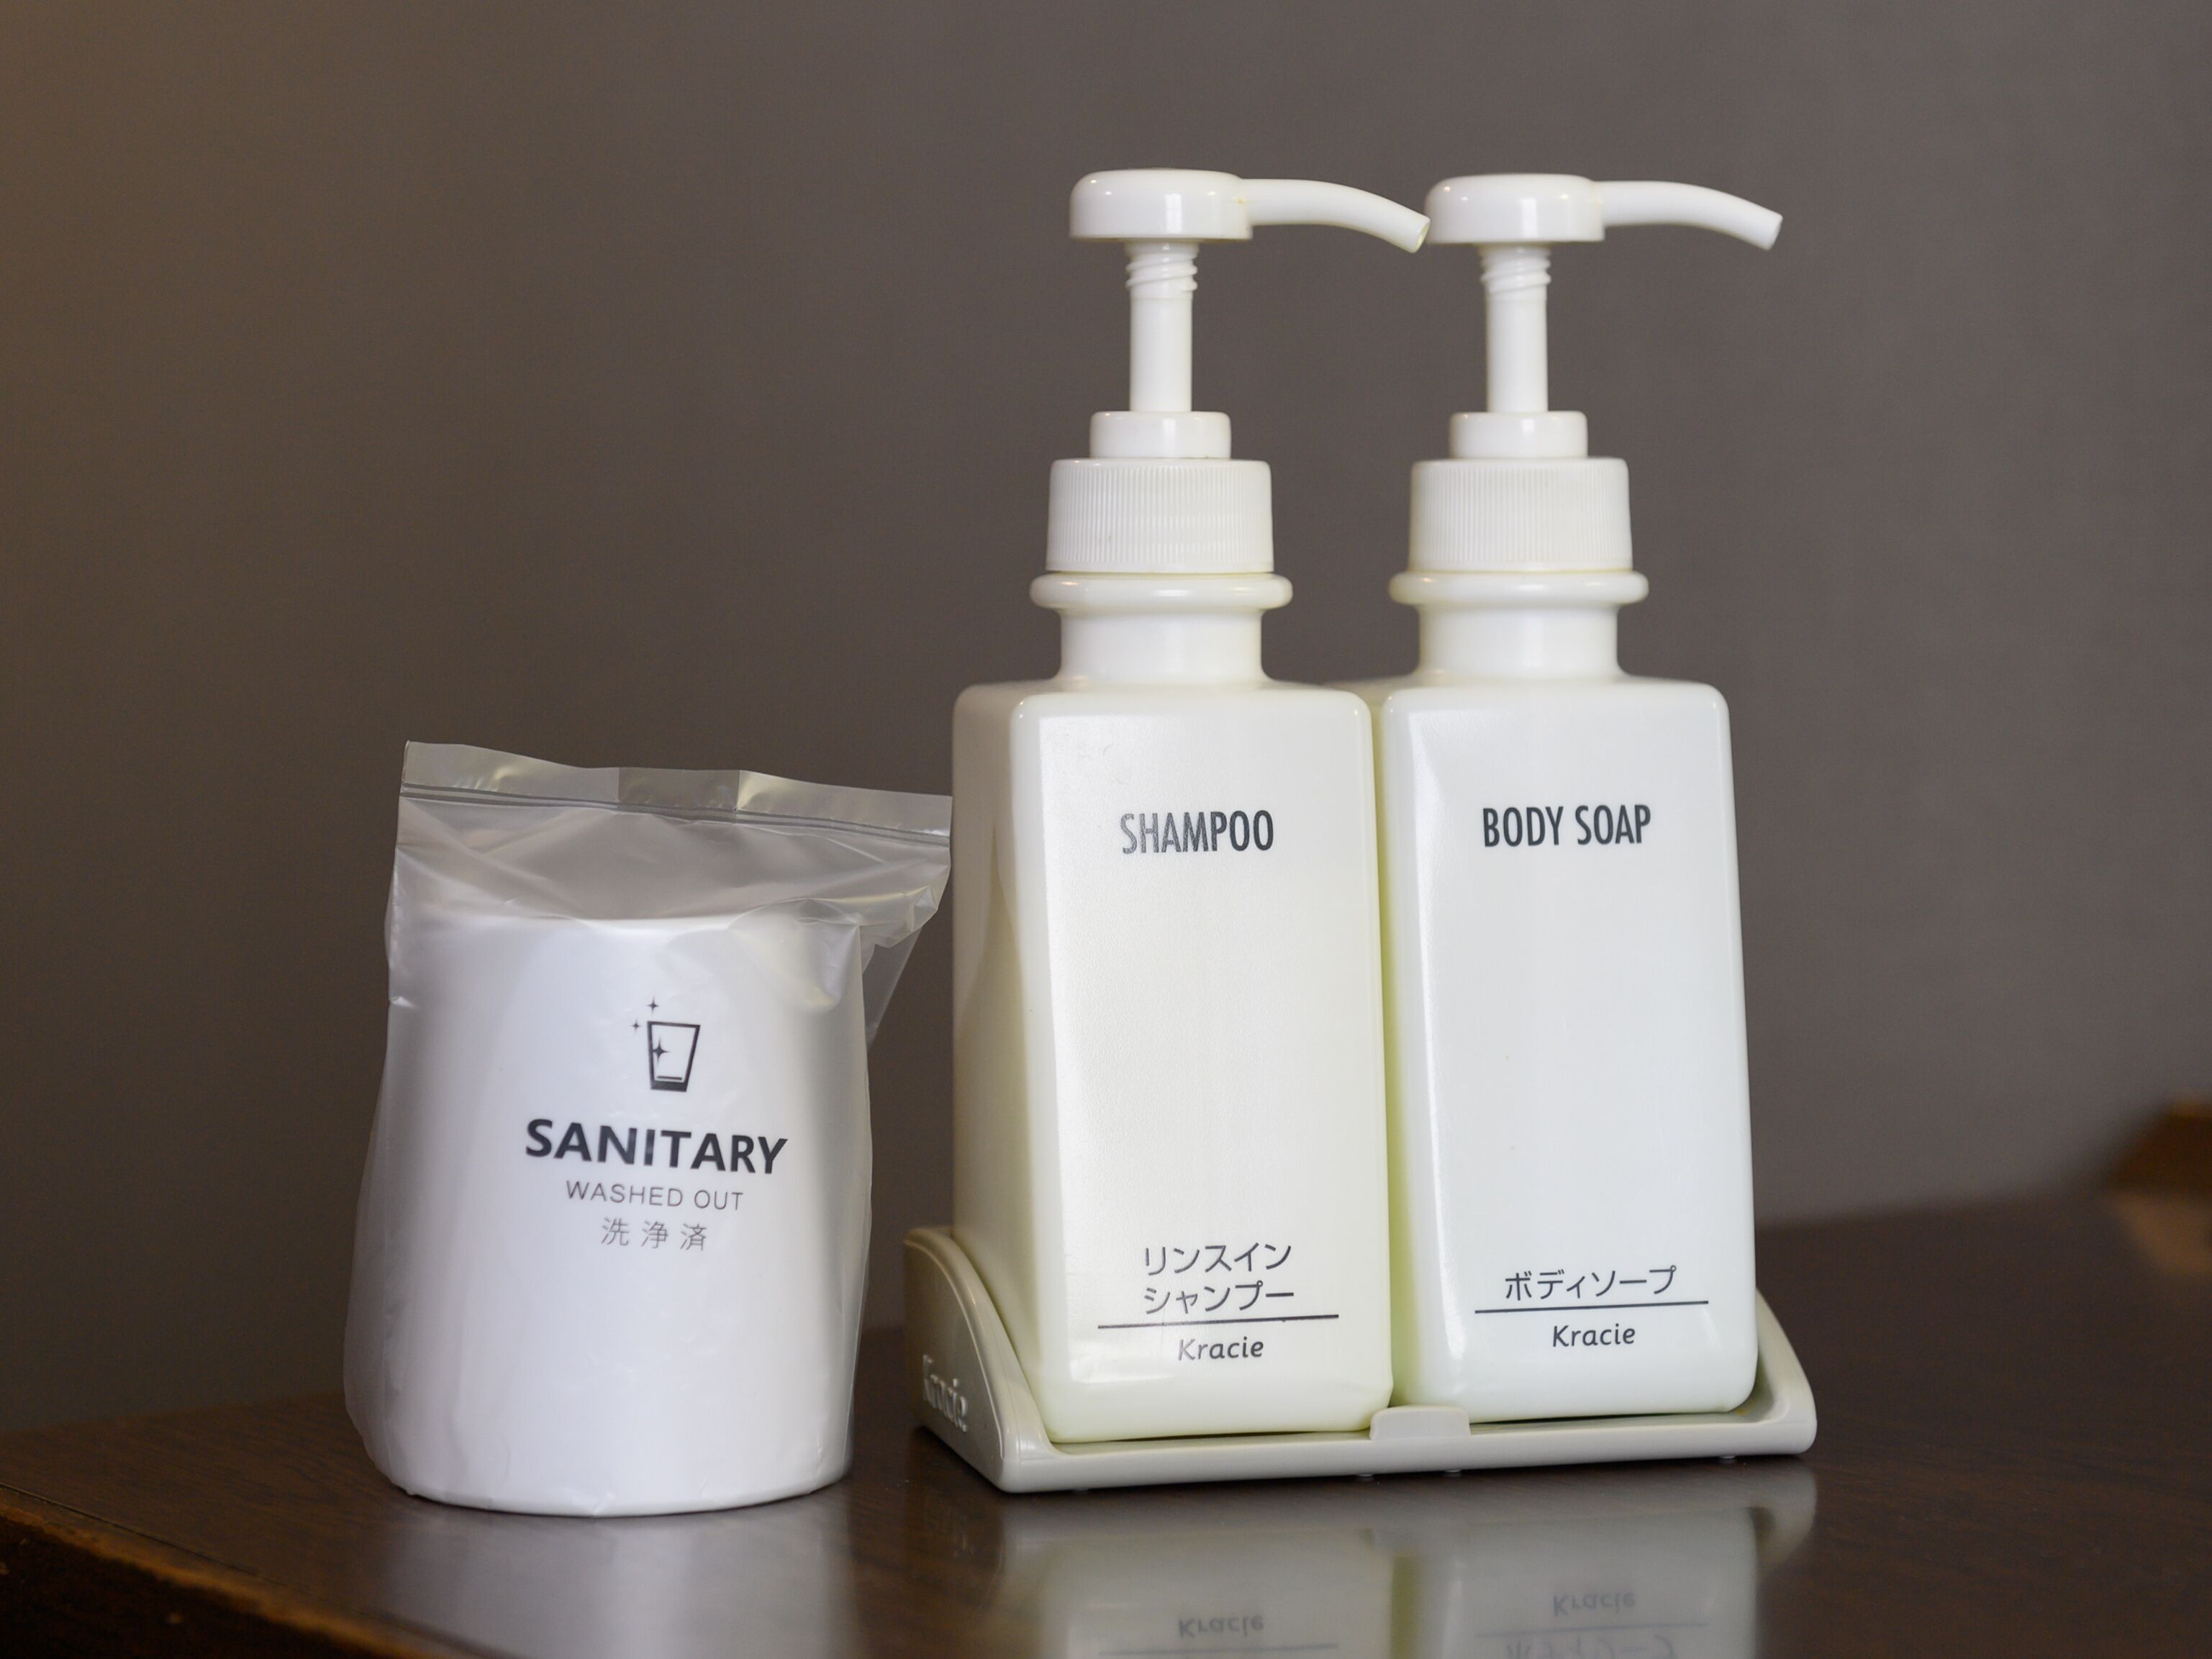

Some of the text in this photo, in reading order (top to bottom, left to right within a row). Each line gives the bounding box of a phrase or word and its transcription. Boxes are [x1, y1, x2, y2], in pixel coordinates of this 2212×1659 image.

[1120, 810, 1274, 855] SHAMPOO
[1483, 804, 1651, 847] BODY SOAP
[526, 1119, 788, 1174] SANITARY
[566, 1180, 744, 1211] WASHED OUT
[600, 1217, 707, 1252] 洗浄済
[1145, 1242, 1292, 1276] リンスイン
[1144, 1280, 1294, 1314] シャンプー
[1505, 1265, 1677, 1301] ボディソープ
[1179, 1336, 1264, 1360] Kracie
[1553, 1323, 1636, 1347] Kracie
